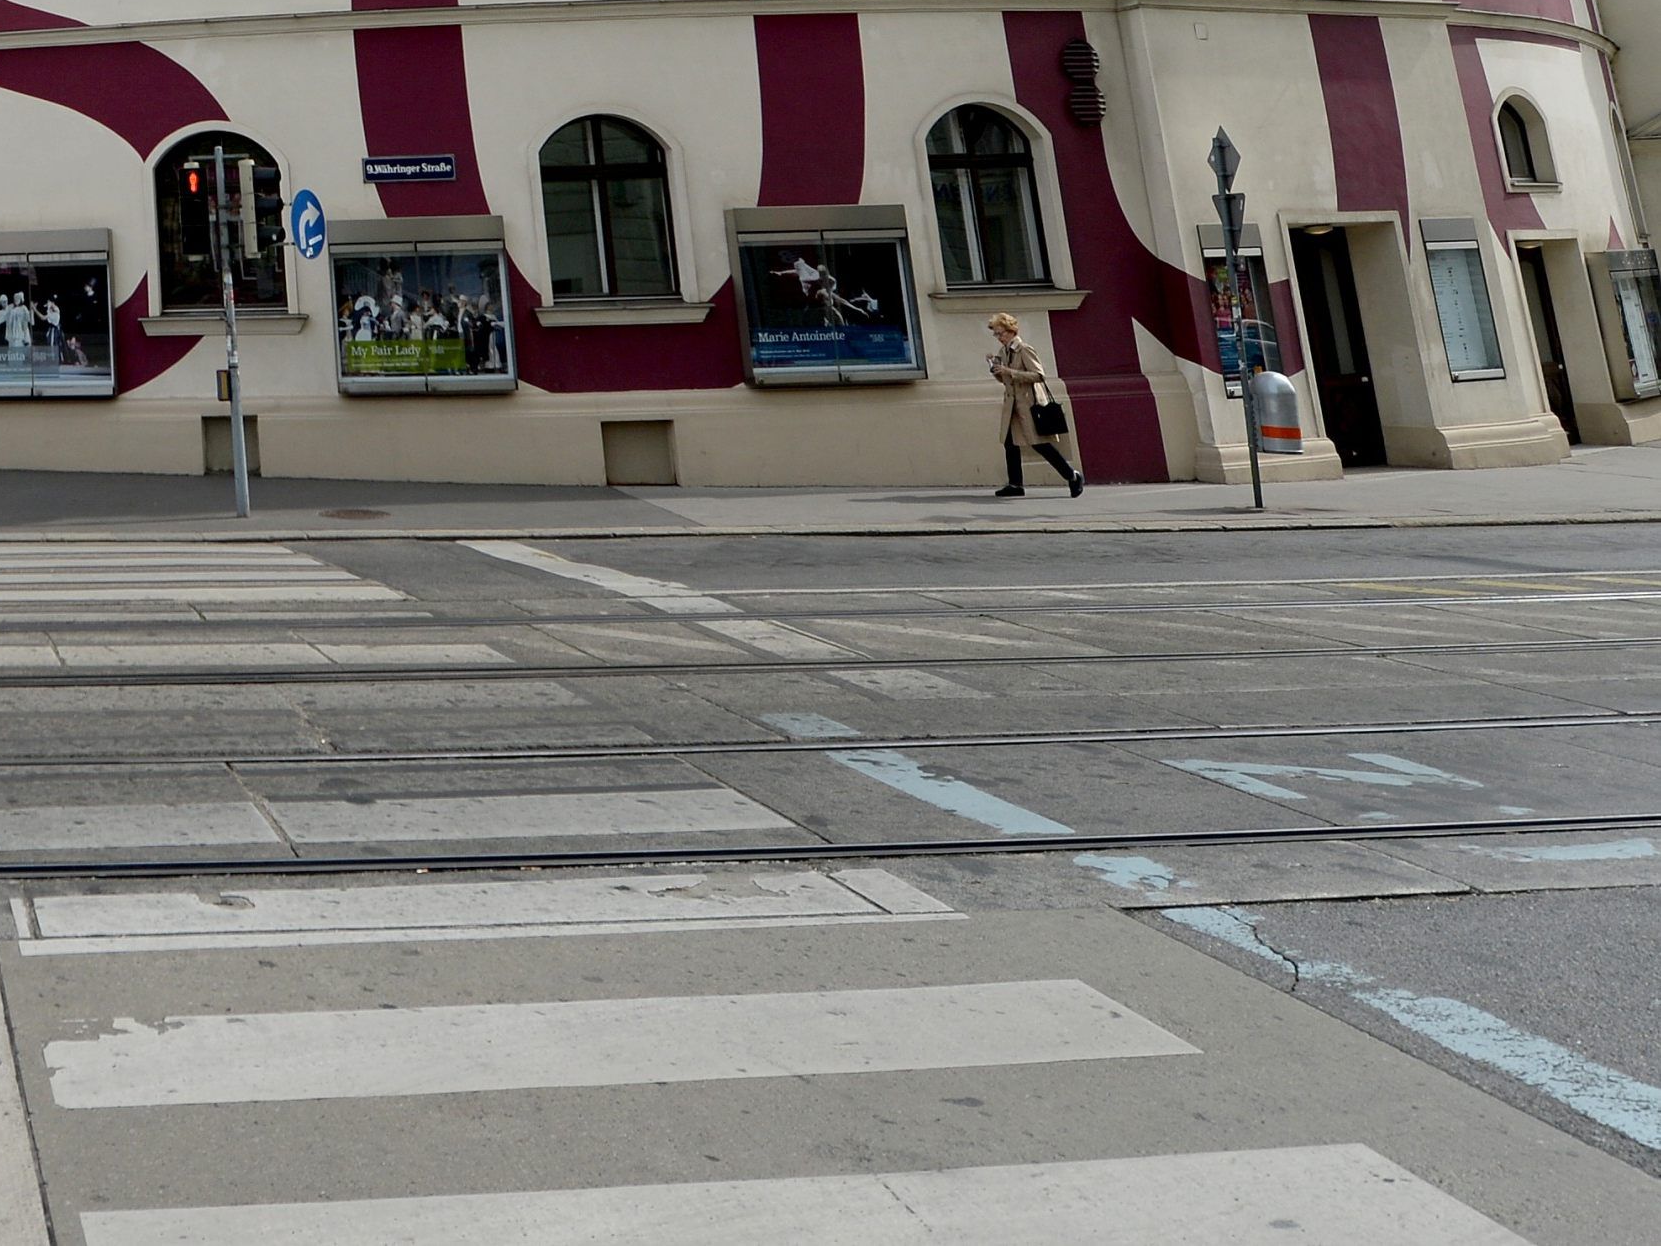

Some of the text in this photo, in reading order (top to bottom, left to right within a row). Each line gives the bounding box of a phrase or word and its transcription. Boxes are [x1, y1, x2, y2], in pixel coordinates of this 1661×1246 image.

[421, 161, 452, 173] Straße
[758, 330, 846, 343] Marie Antoinette
[351, 345, 368, 357] My
[371, 344, 393, 355] Fair
[395, 343, 422, 357] Lady
